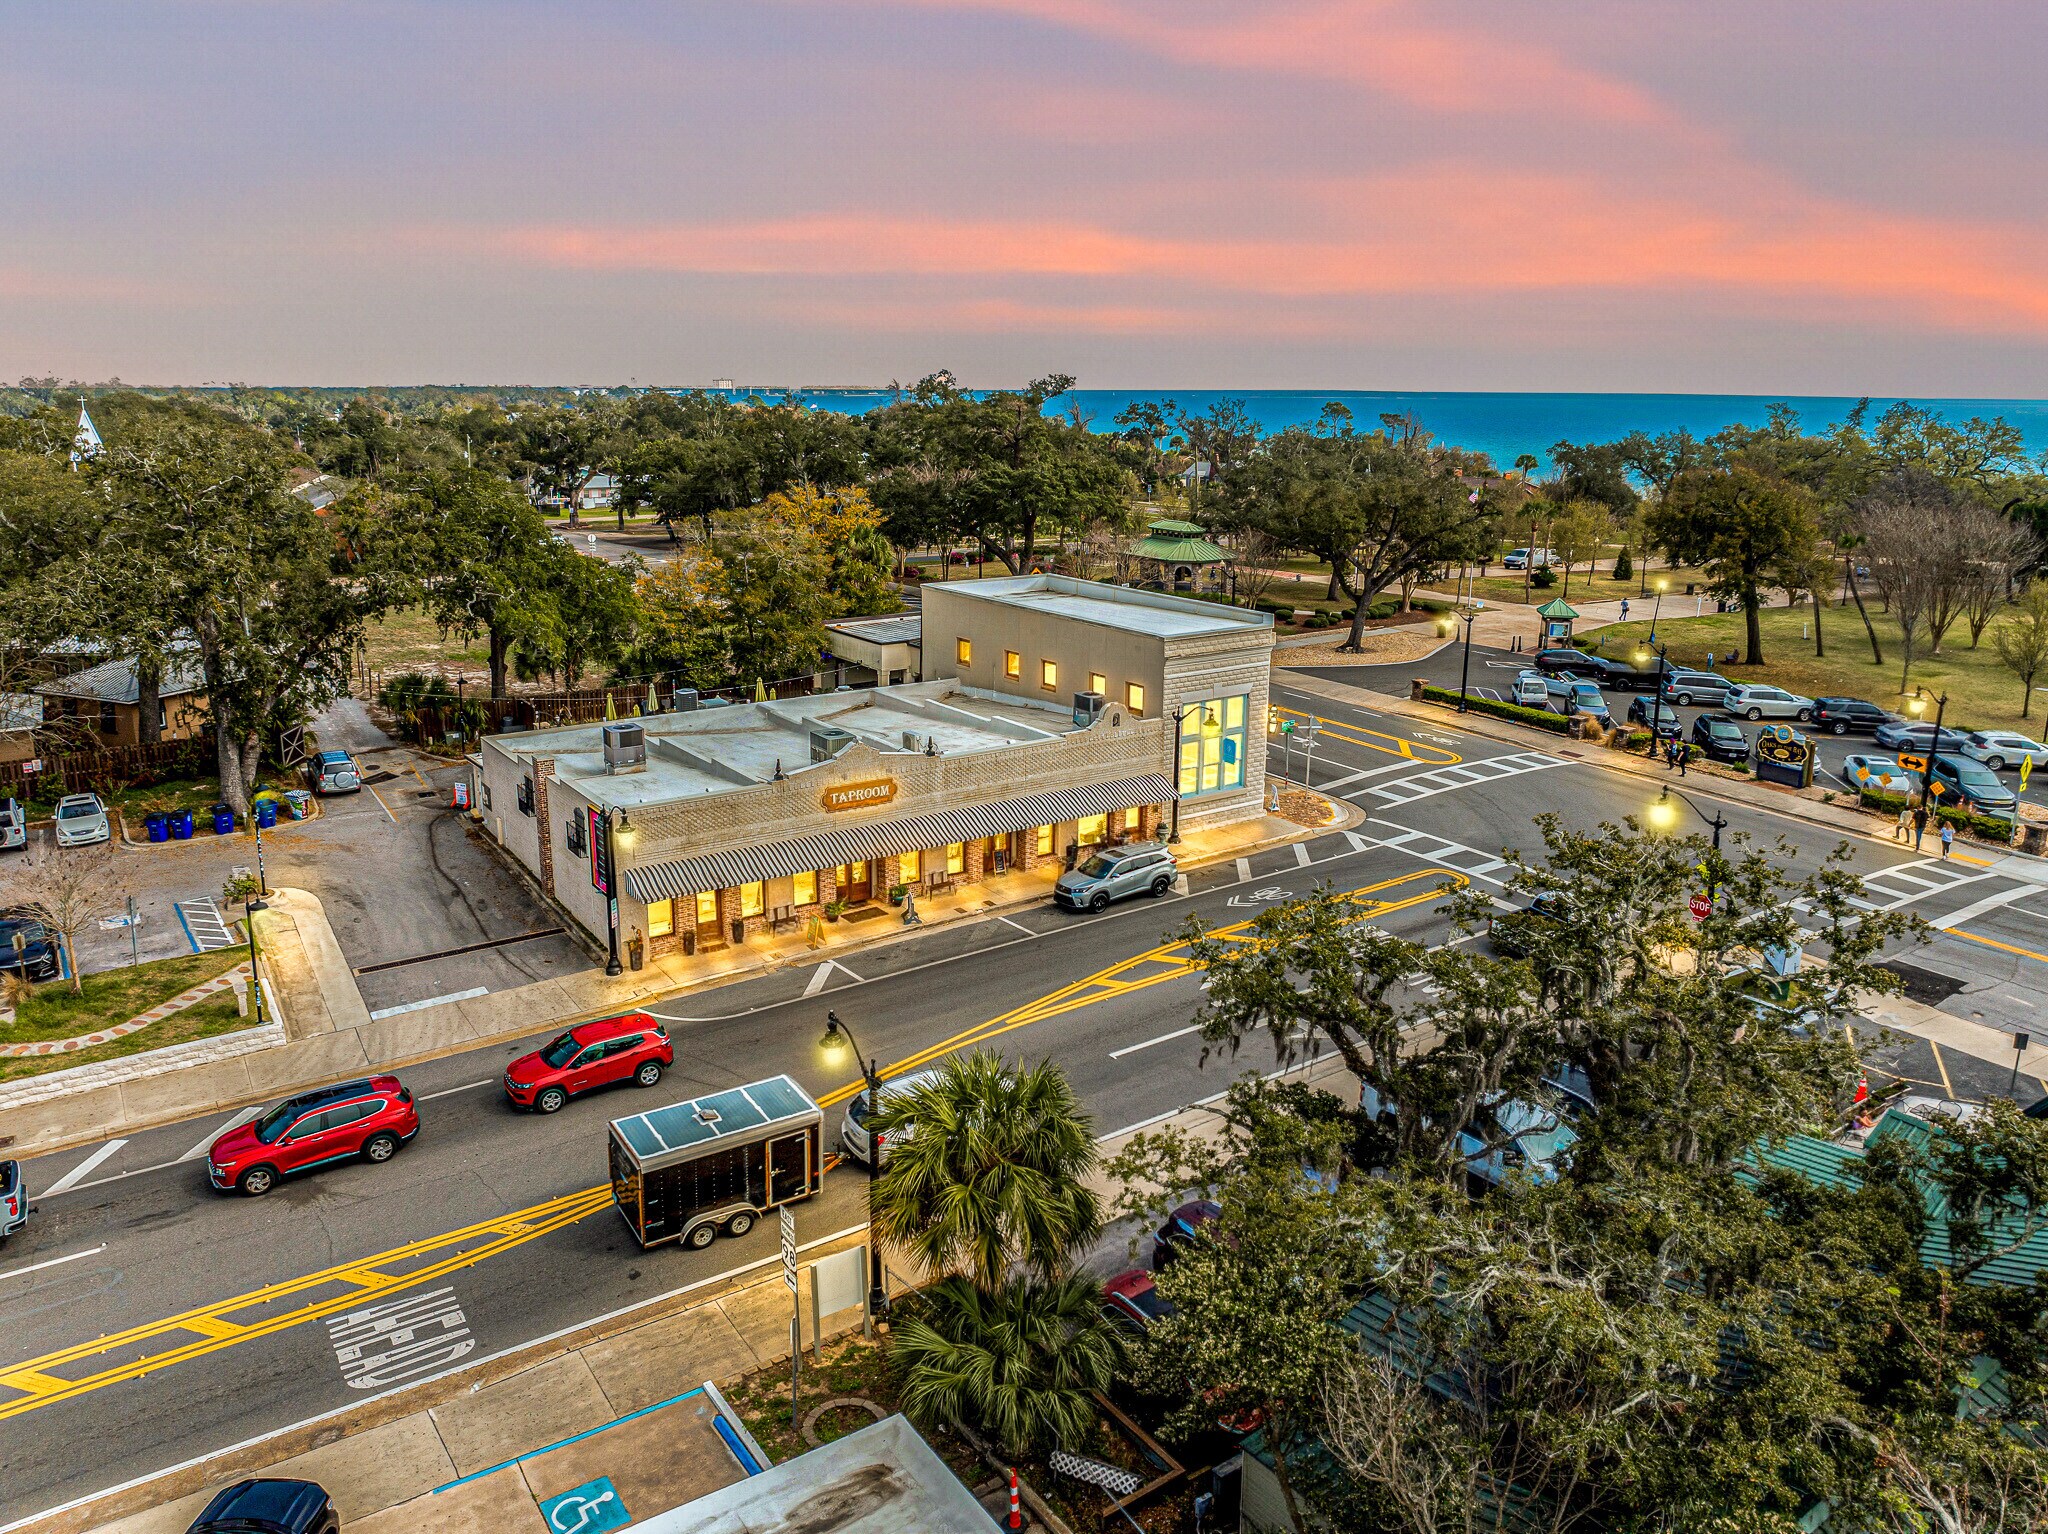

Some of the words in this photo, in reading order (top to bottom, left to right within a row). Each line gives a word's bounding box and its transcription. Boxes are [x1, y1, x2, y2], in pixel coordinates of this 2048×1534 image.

[830, 784, 890, 805] TAPROOM
[1690, 899, 1711, 912] STOP
[781, 1208, 793, 1226] EAST
[782, 1242, 796, 1268] 98
[325, 1285, 476, 1389] AHEAD
